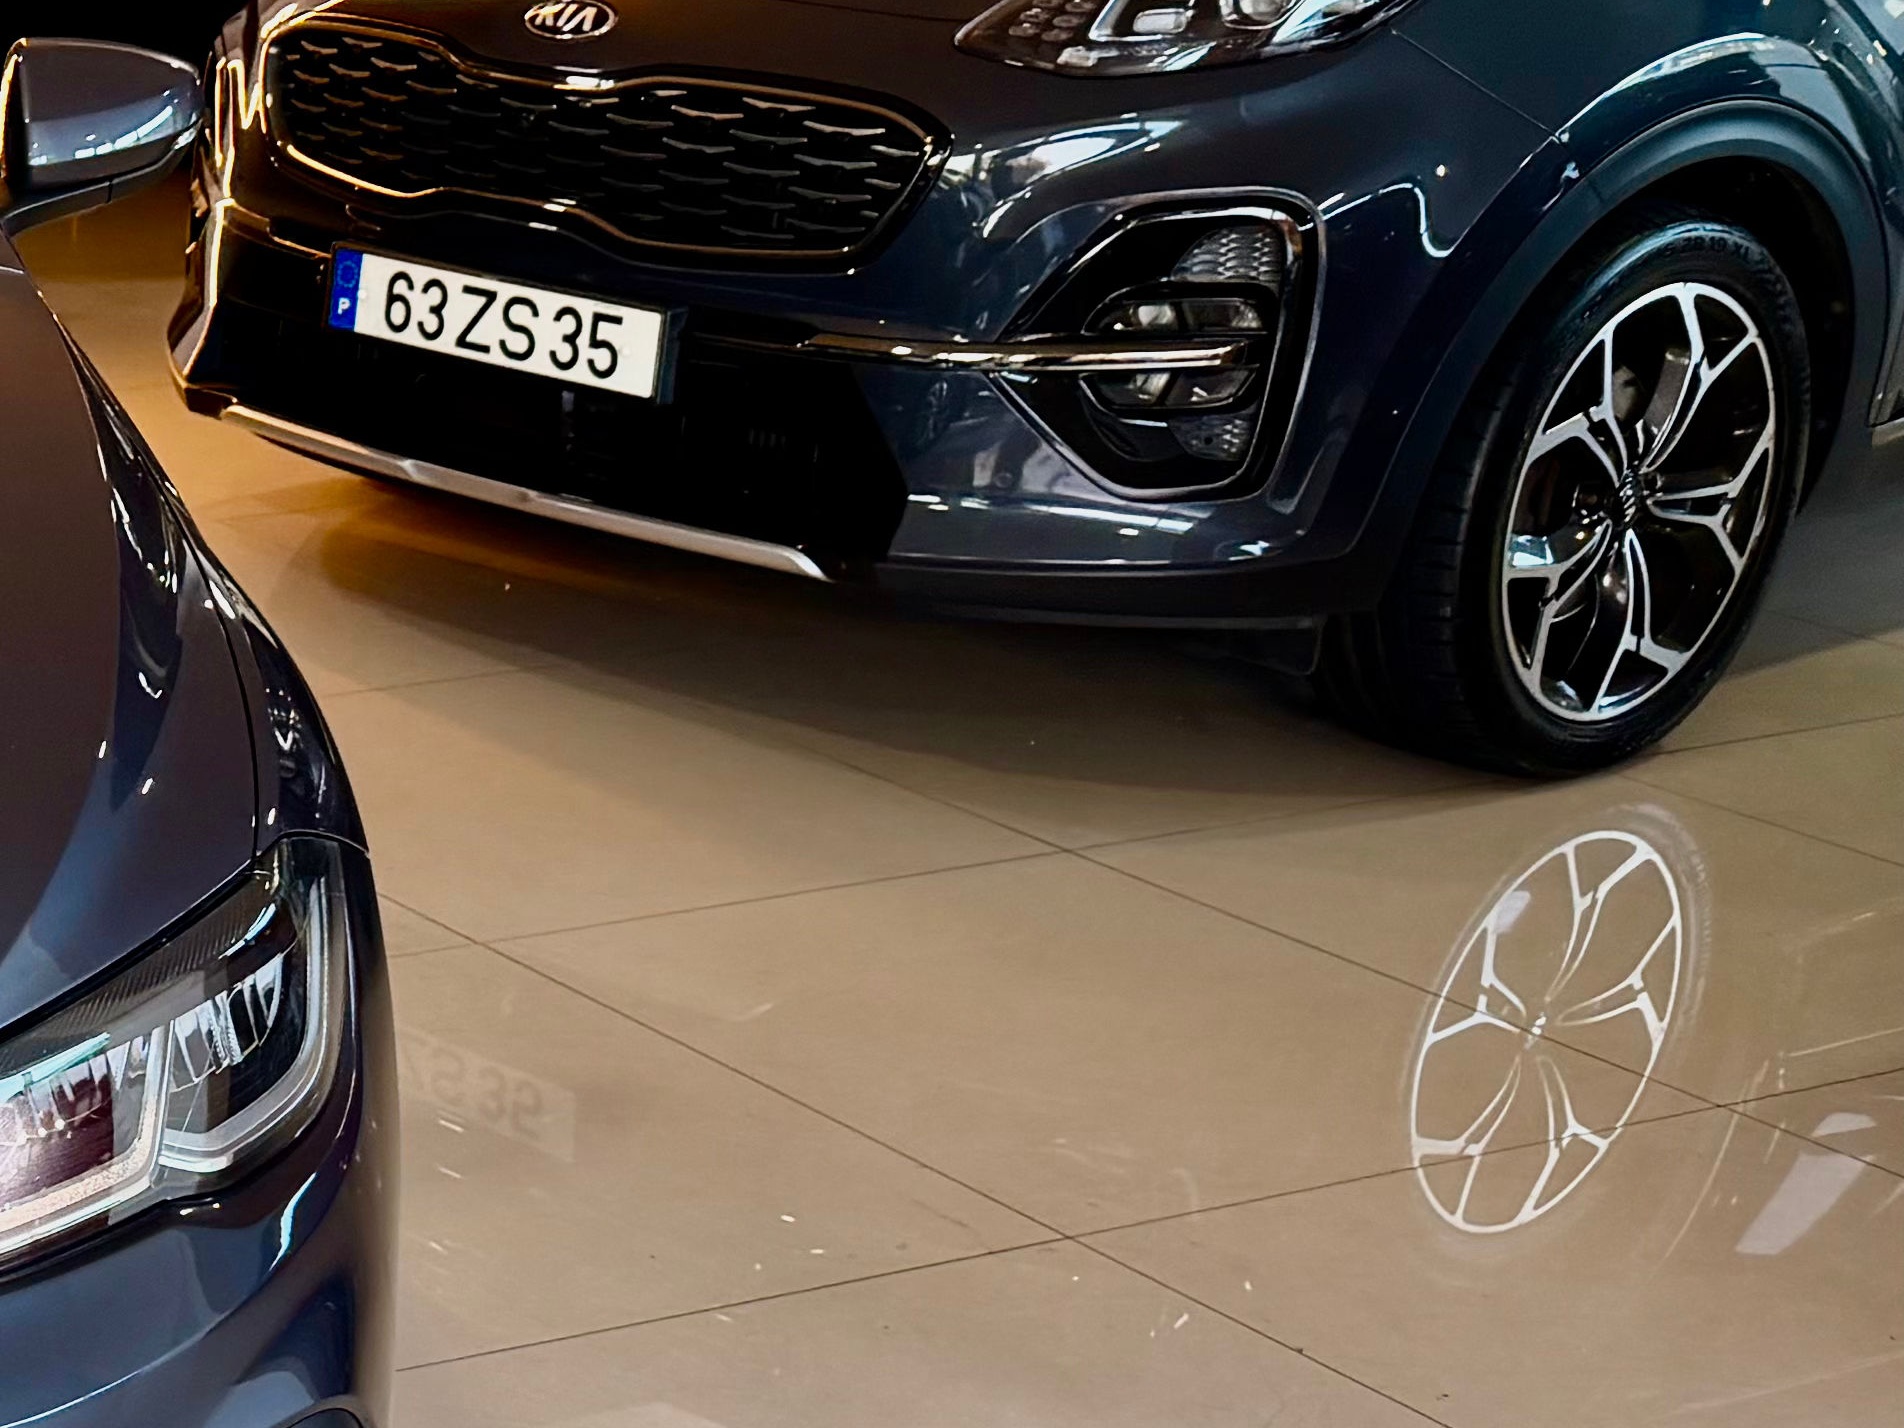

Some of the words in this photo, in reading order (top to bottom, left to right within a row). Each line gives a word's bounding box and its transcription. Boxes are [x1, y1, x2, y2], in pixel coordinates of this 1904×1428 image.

[532, 1, 599, 33] KIA
[337, 297, 351, 315] P
[384, 270, 624, 379] 63ZS35
